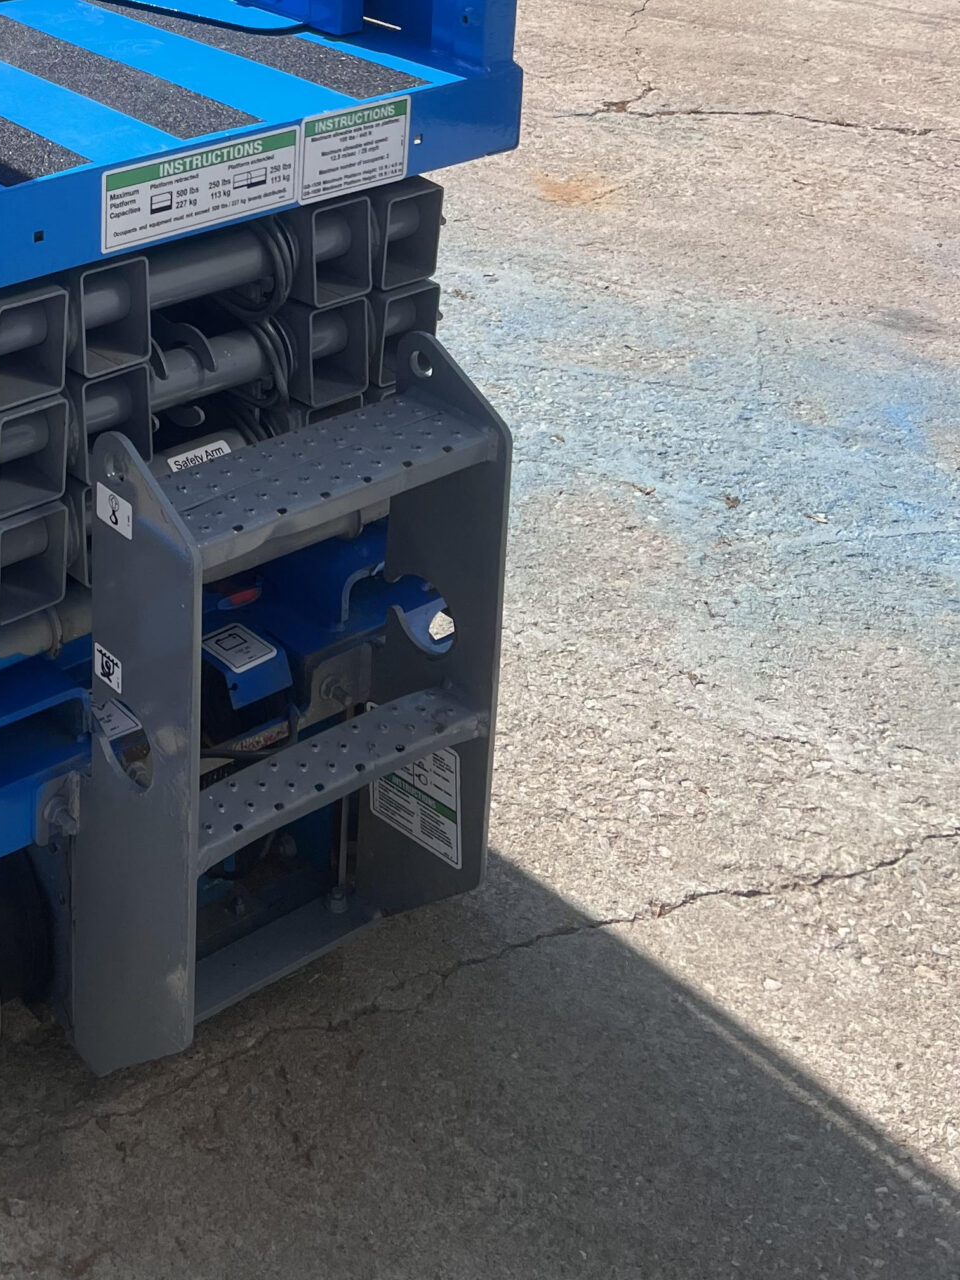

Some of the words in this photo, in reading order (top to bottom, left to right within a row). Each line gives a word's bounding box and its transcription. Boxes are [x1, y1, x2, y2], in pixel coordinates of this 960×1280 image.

[315, 105, 395, 133] INSTRUCTIONS
[160, 141, 262, 176] INSTRUCTIONS
[209, 181, 219, 189] 250
[221, 178, 231, 186] lbs
[110, 190, 139, 200] Maximum
[176, 189, 187, 198] 500
[211, 191, 221, 199] 113
[110, 199, 136, 210] Platform
[176, 200, 186, 209] 227
[110, 207, 140, 219] Capacities
[174, 453, 204, 470] Safety
[205, 447, 224, 459] Arm
